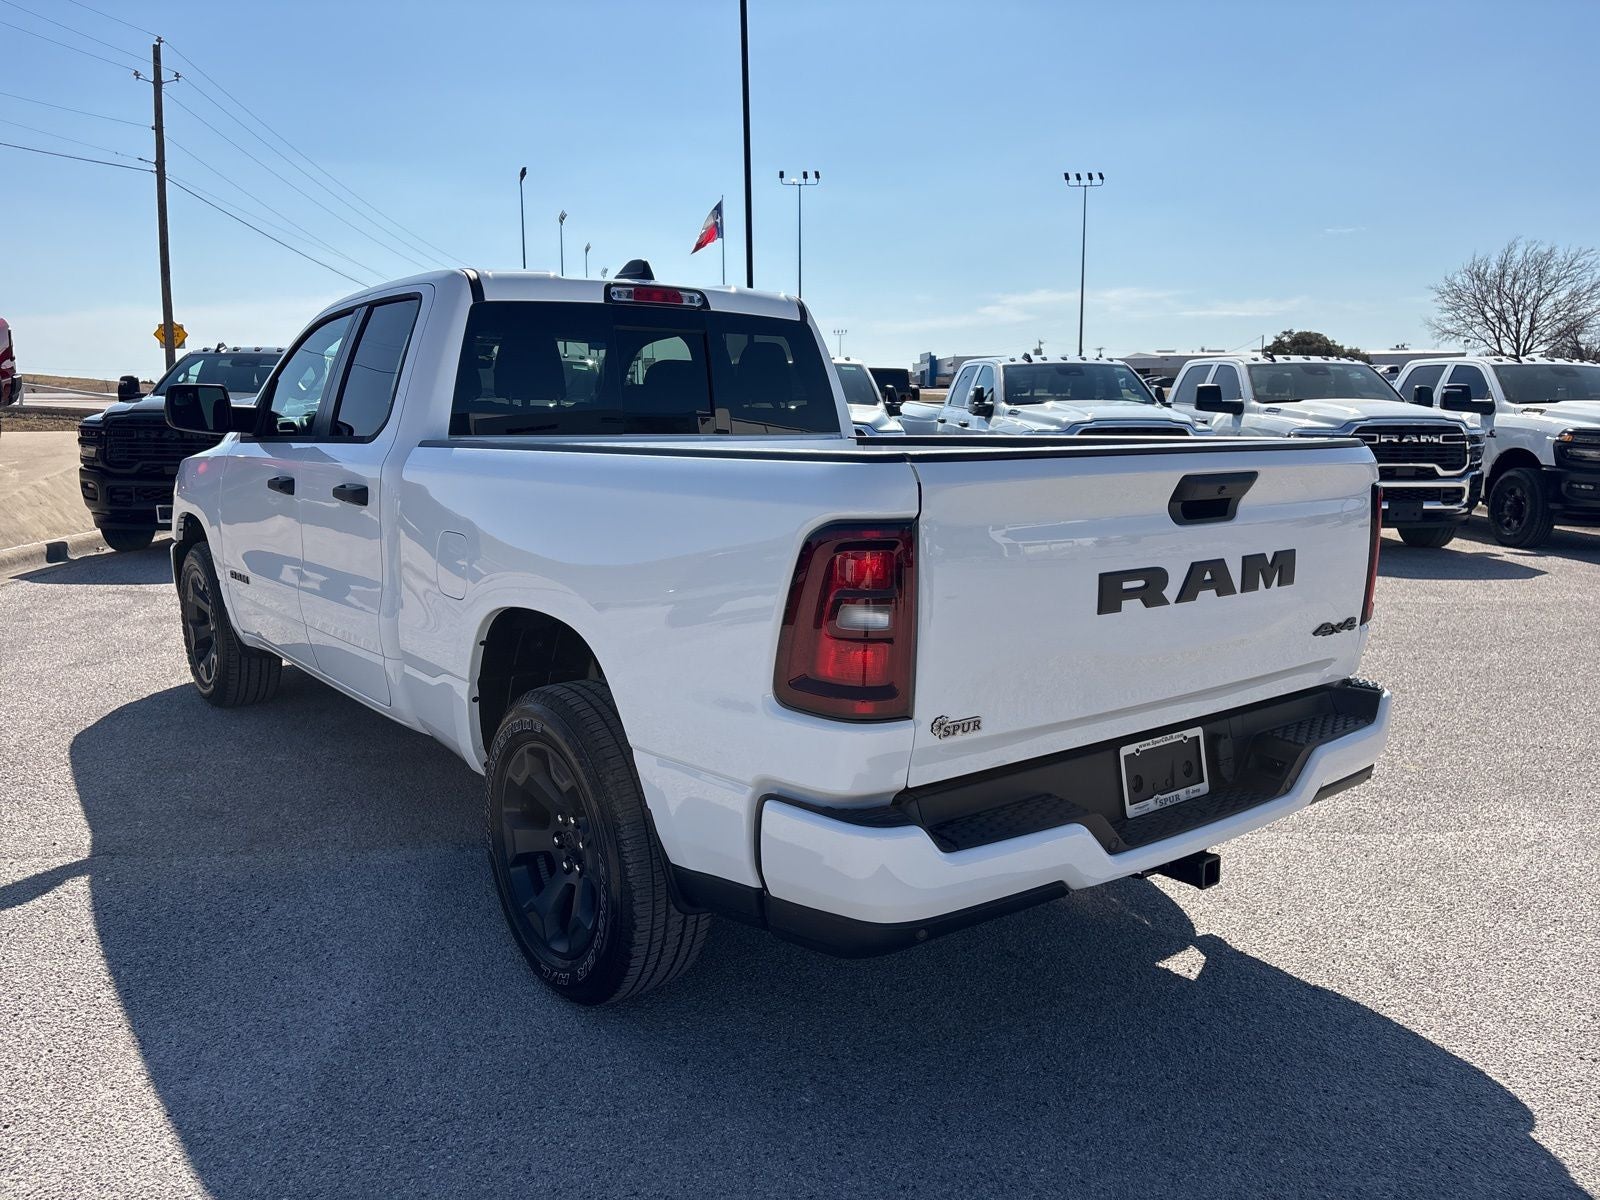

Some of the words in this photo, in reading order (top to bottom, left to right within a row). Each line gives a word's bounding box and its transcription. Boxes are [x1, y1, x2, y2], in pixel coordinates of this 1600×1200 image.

[1380, 433, 1440, 443] RAM
[1097, 549, 1296, 615] RAM
[1312, 617, 1356, 636] 4x4
[943, 720, 981, 738] SPUR
[1159, 794, 1180, 806] SPUR
